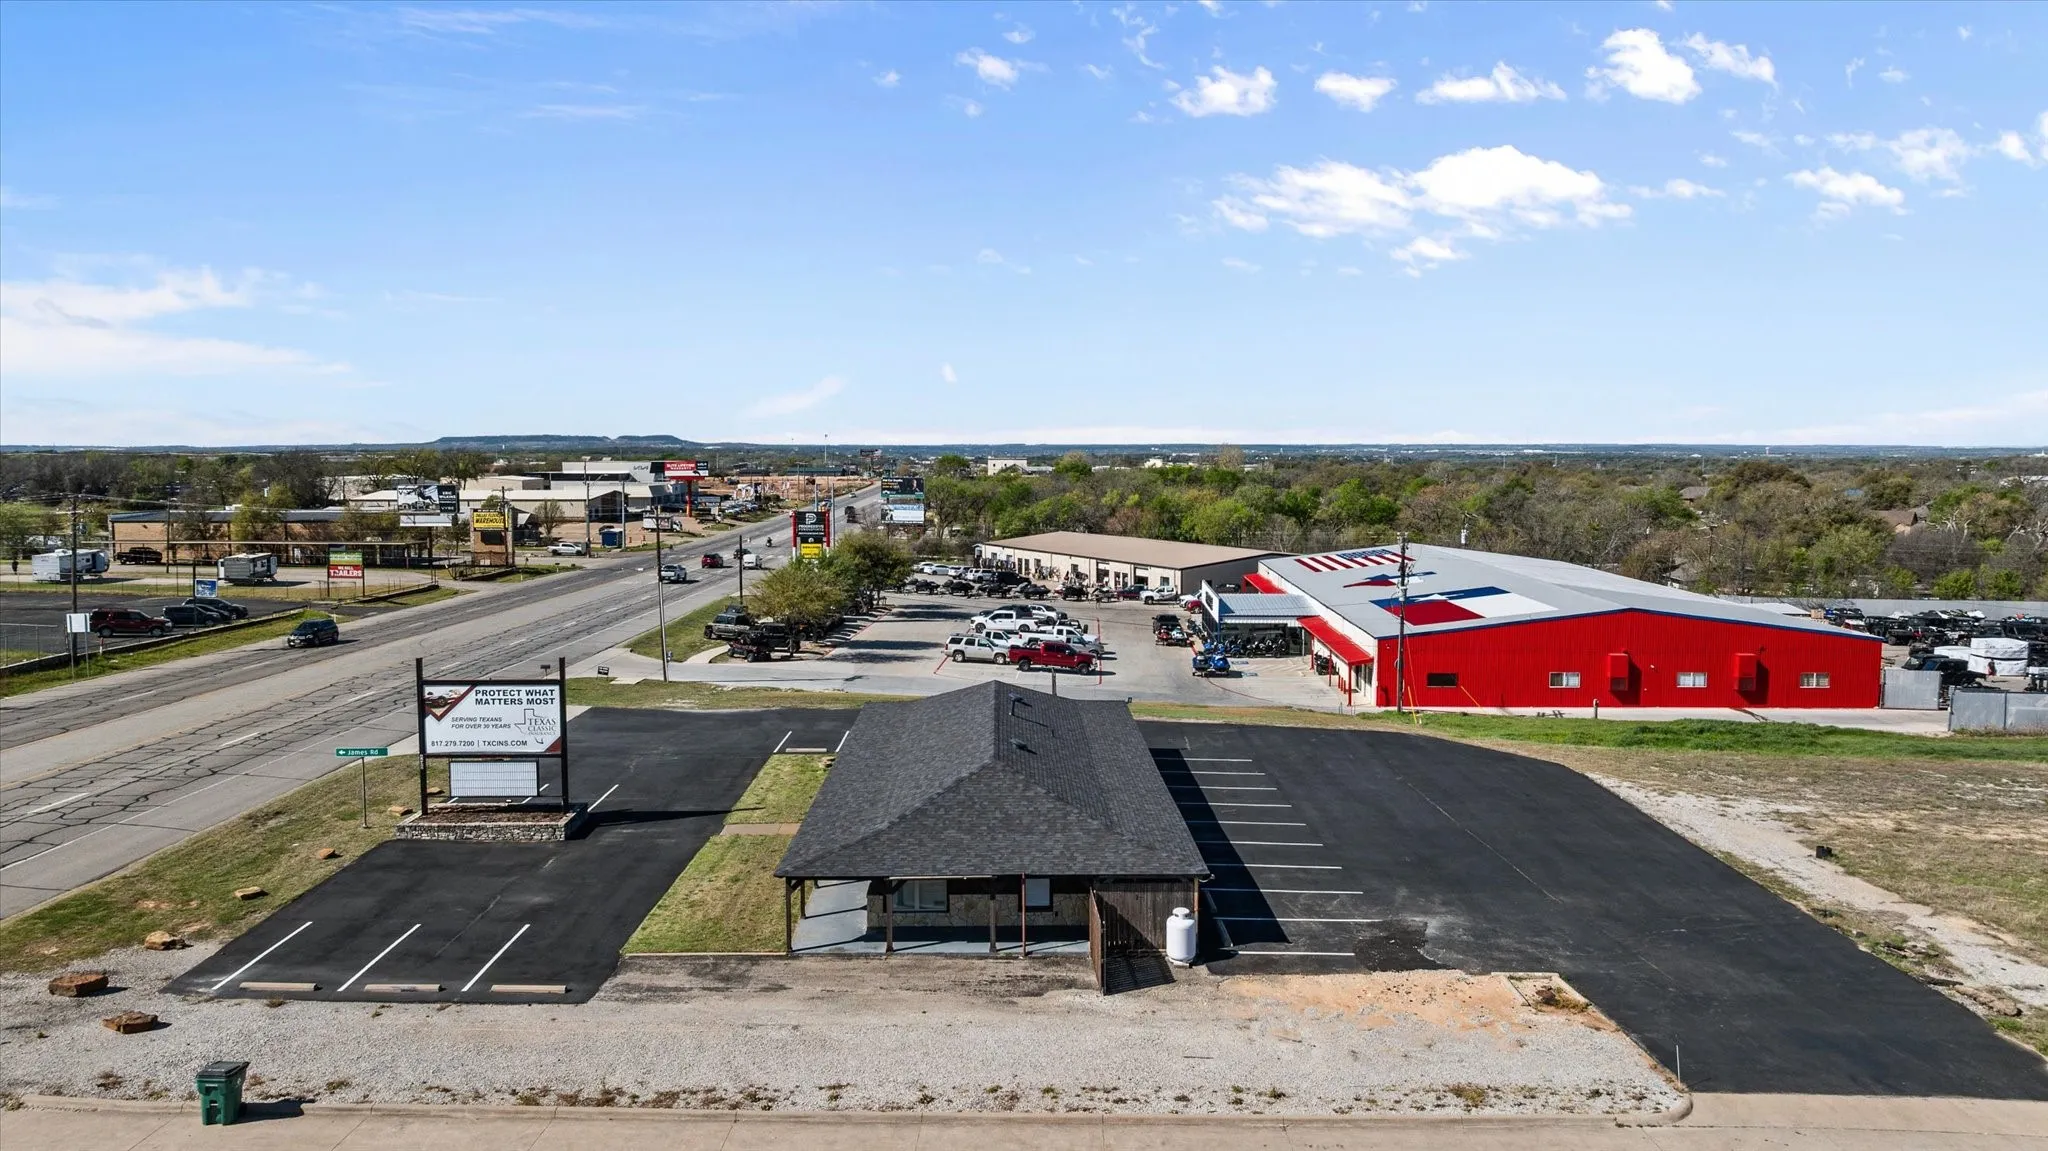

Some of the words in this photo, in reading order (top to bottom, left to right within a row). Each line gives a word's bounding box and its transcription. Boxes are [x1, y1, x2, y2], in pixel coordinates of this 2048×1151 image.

[475, 689, 522, 697] PROTECT
[525, 689, 556, 697] WHAT
[527, 718, 556, 726] TEXAS
